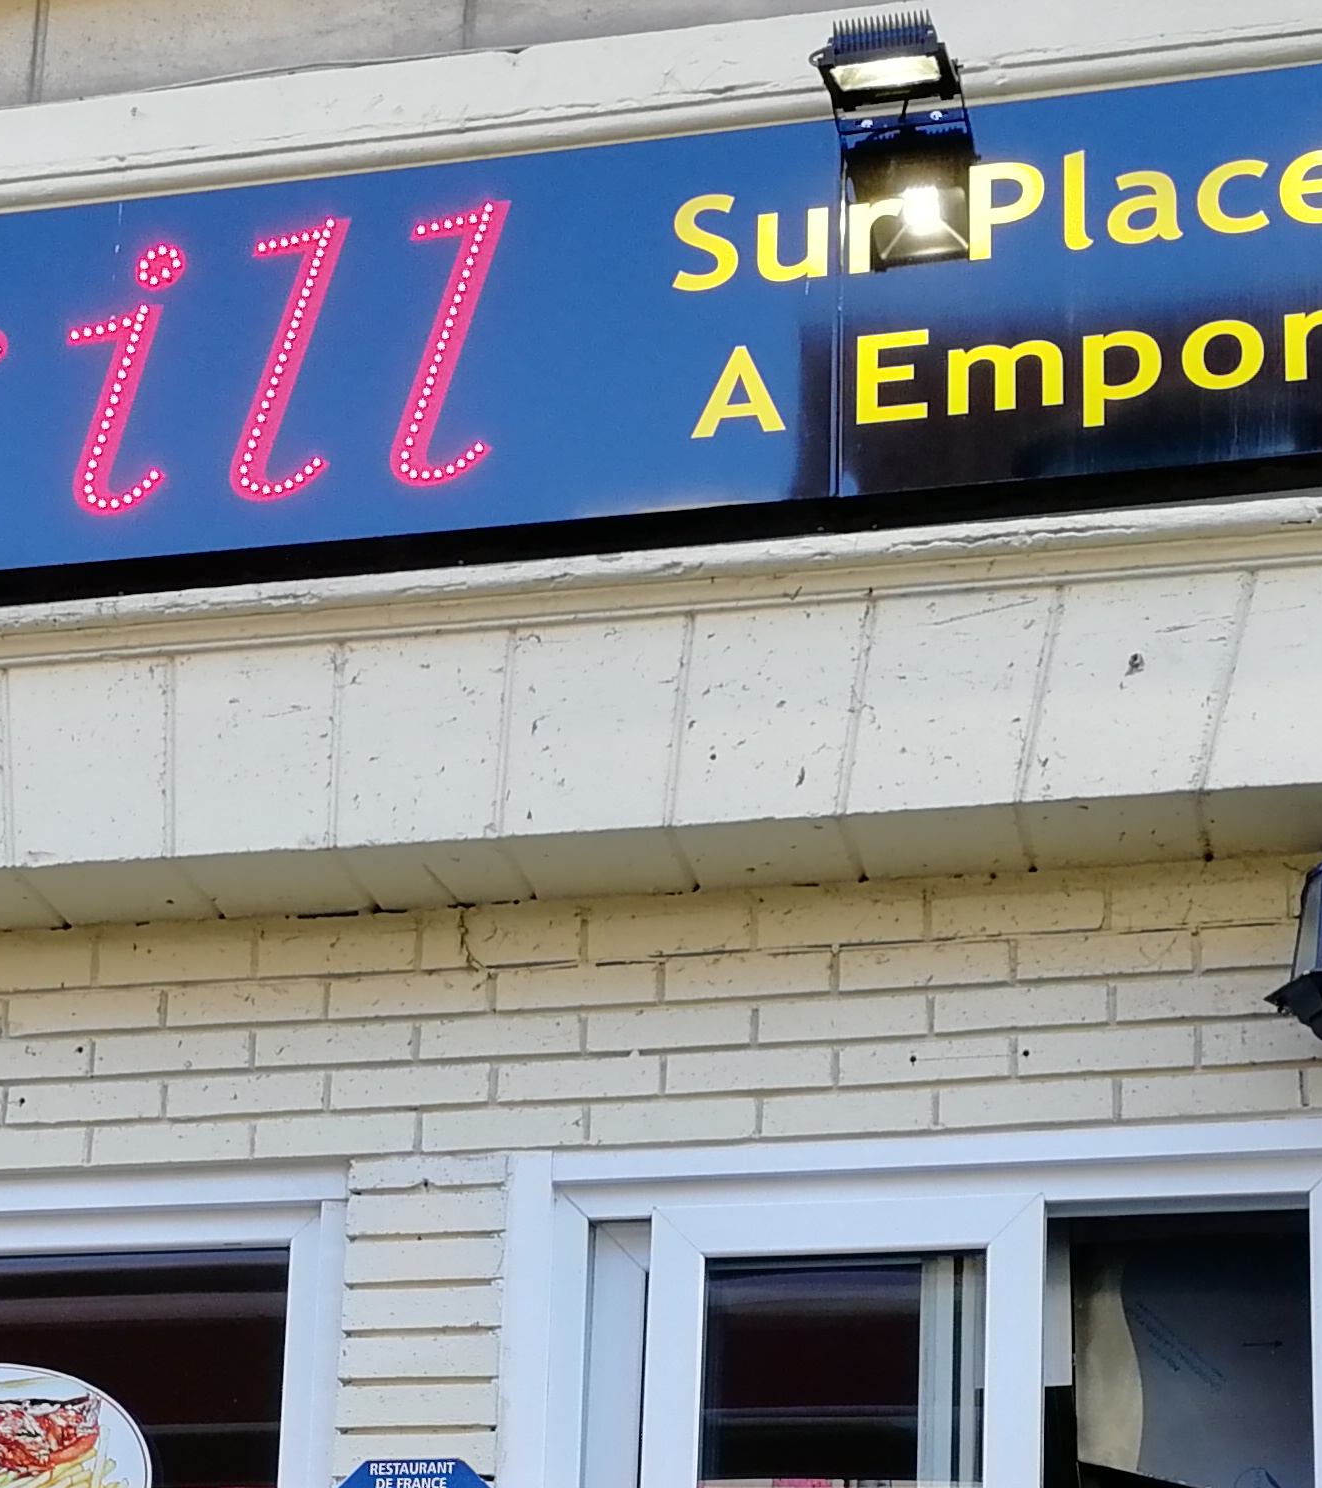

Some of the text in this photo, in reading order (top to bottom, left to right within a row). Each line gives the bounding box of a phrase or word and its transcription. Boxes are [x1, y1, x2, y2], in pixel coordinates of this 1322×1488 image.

[671, 192, 907, 292] Sur
[691, 345, 786, 440] A
[369, 1461, 456, 1476] RESTAURANT
